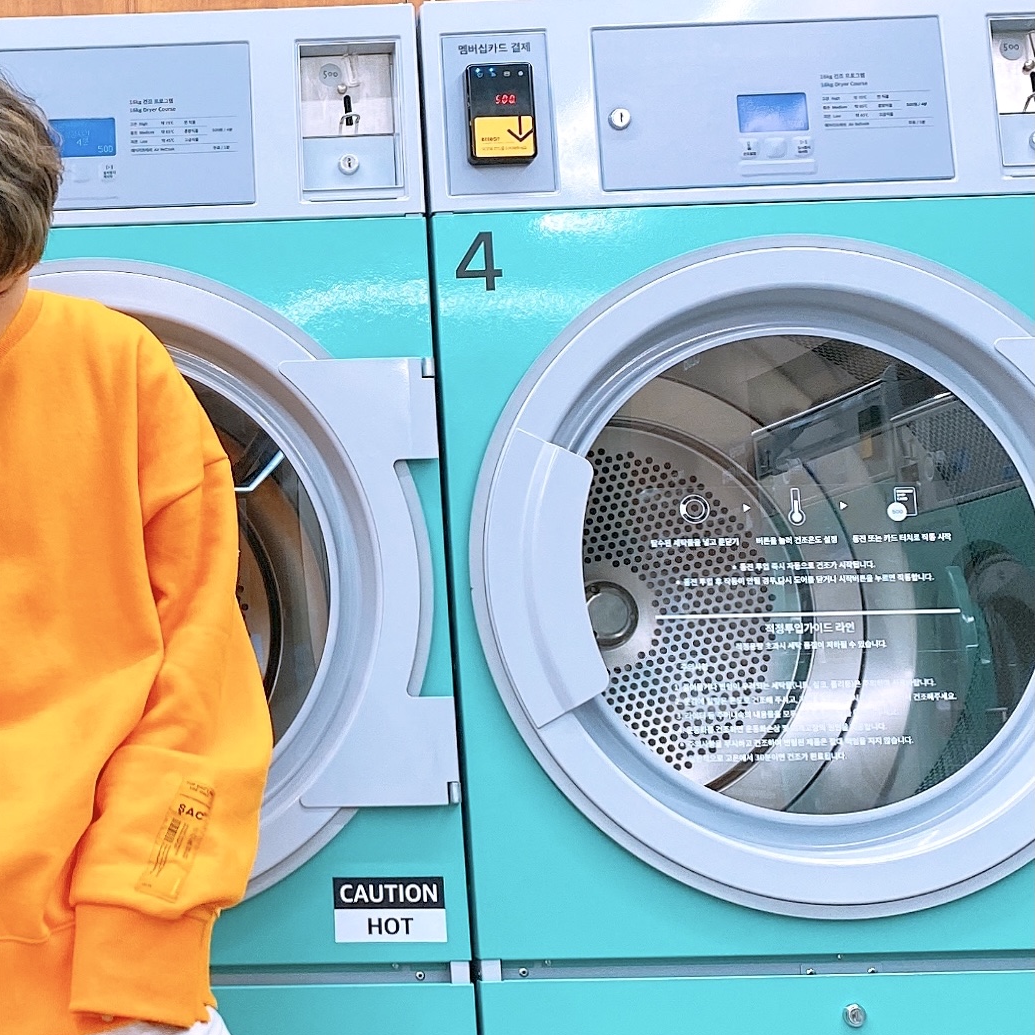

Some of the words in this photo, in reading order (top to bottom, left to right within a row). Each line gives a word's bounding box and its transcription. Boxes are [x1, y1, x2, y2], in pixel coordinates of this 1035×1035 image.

[458, 44, 508, 55] 멤버십카드
[511, 42, 531, 53] 결제
[1003, 42, 1019, 51] 500
[323, 71, 338, 79] 500
[495, 93, 517, 104] 500
[97, 145, 114, 154] 500
[456, 231, 503, 291] 4
[764, 623, 833, 634] 적정투입가이드
[835, 621, 855, 633] 라인
[339, 884, 438, 903] CAUTION
[367, 917, 414, 935] HOT
